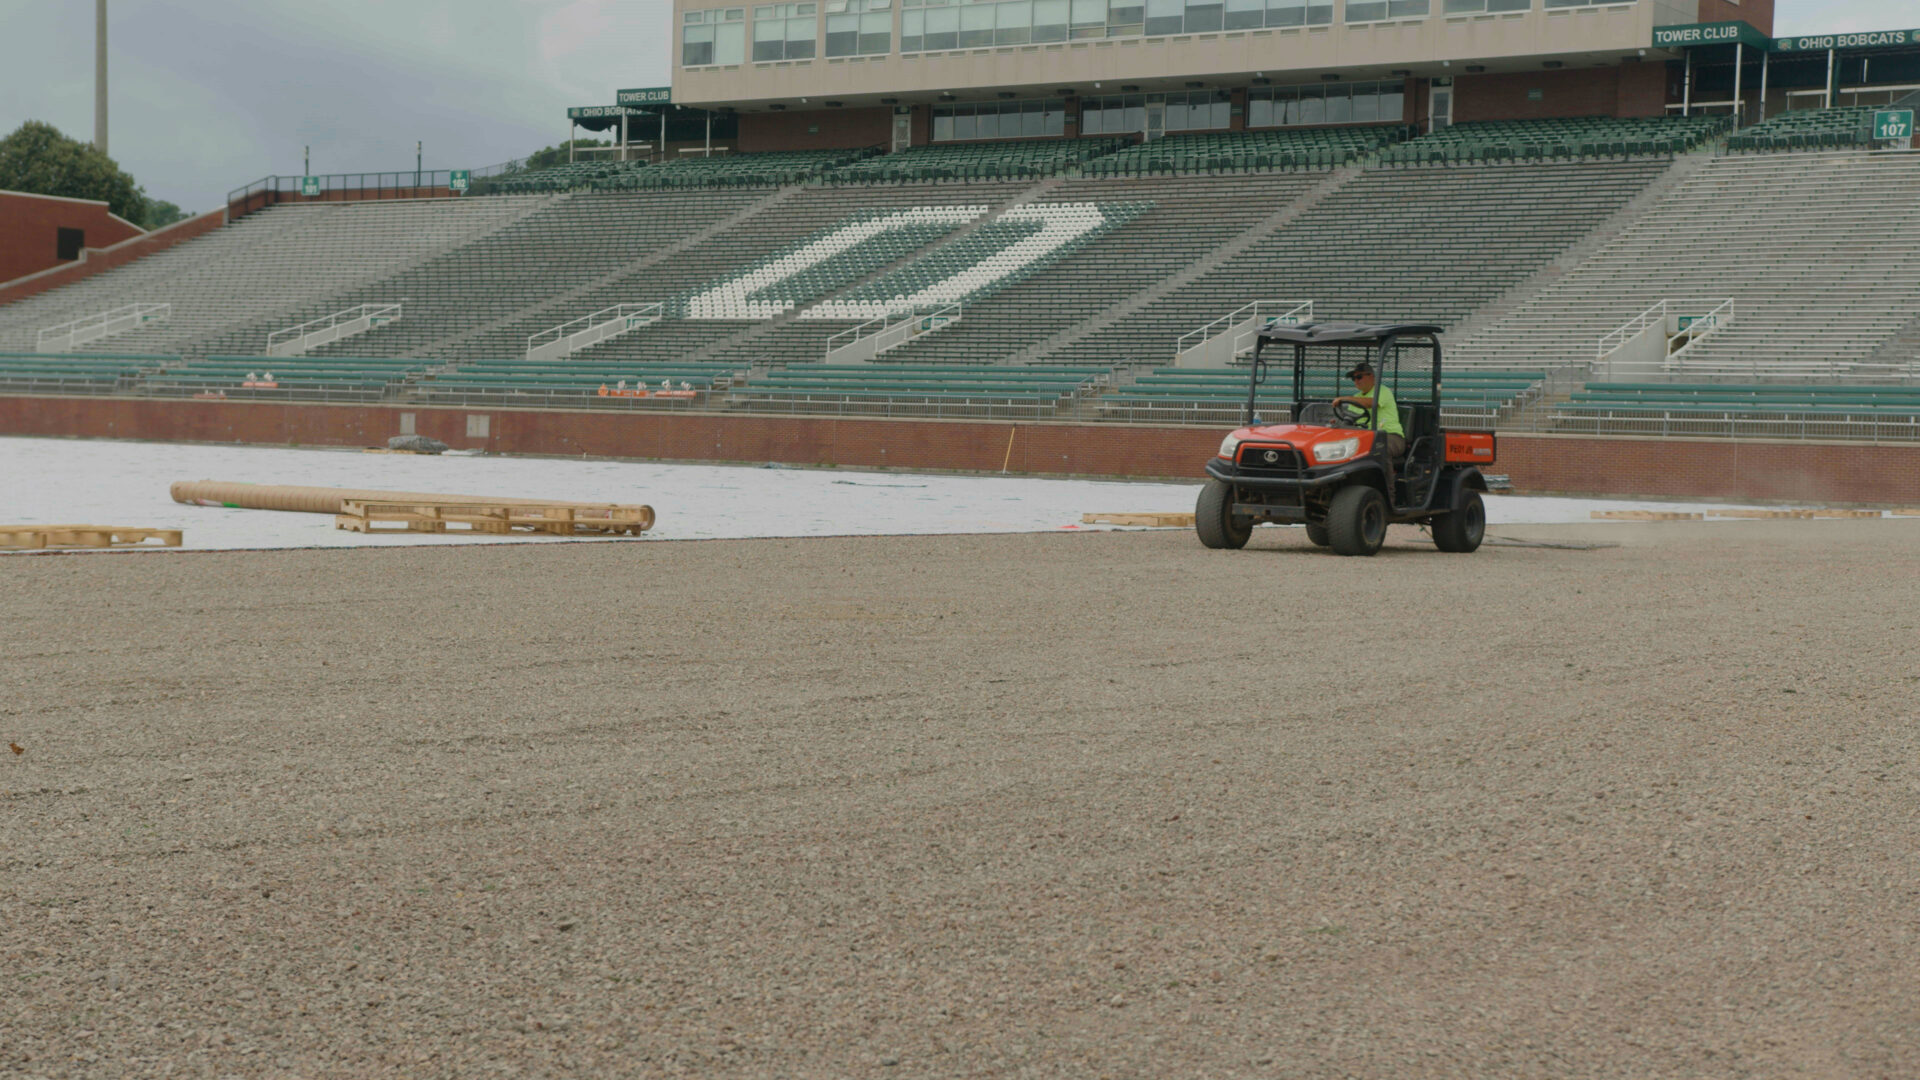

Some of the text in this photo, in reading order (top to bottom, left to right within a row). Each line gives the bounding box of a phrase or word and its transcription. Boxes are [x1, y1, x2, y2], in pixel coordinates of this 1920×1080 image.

[1656, 26, 1738, 42] TOWER CLUB
[1799, 31, 1905, 49] OHIO BOBCATS
[619, 90, 669, 102] TOWER CLUB
[583, 108, 603, 117] OHIO
[1880, 124, 1907, 137] 107
